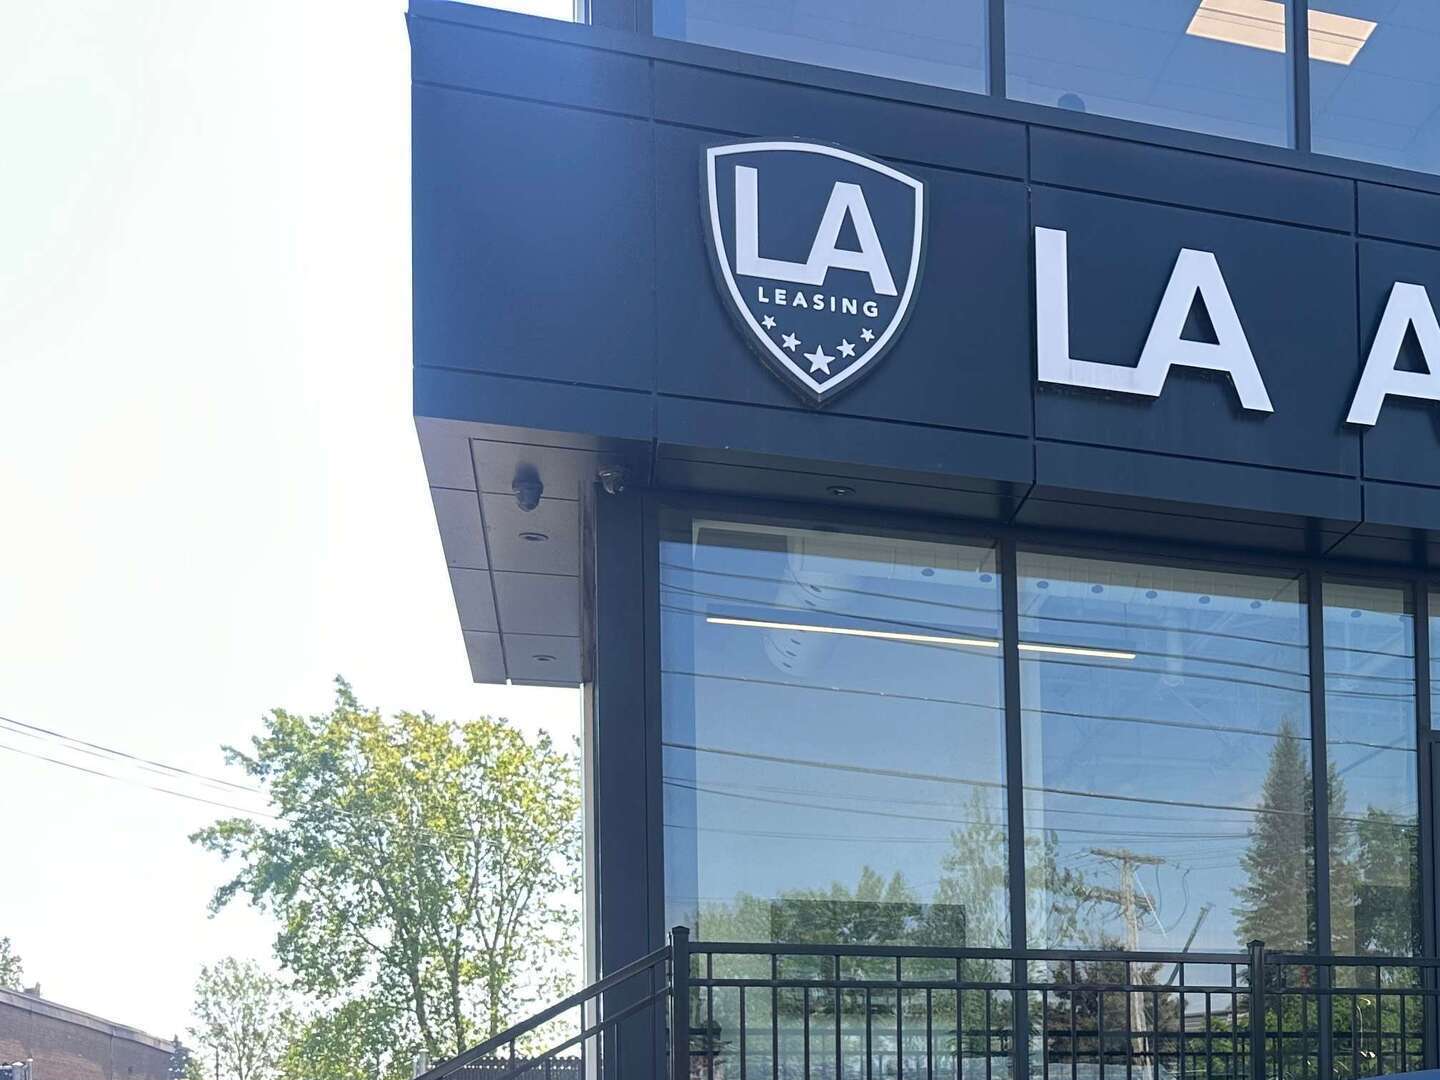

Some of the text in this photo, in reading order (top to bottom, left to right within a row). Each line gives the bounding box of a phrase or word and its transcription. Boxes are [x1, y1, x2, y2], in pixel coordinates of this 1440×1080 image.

[735, 165, 898, 296] LA
[757, 286, 879, 317] LEASING
[1035, 226, 1274, 413] LA
